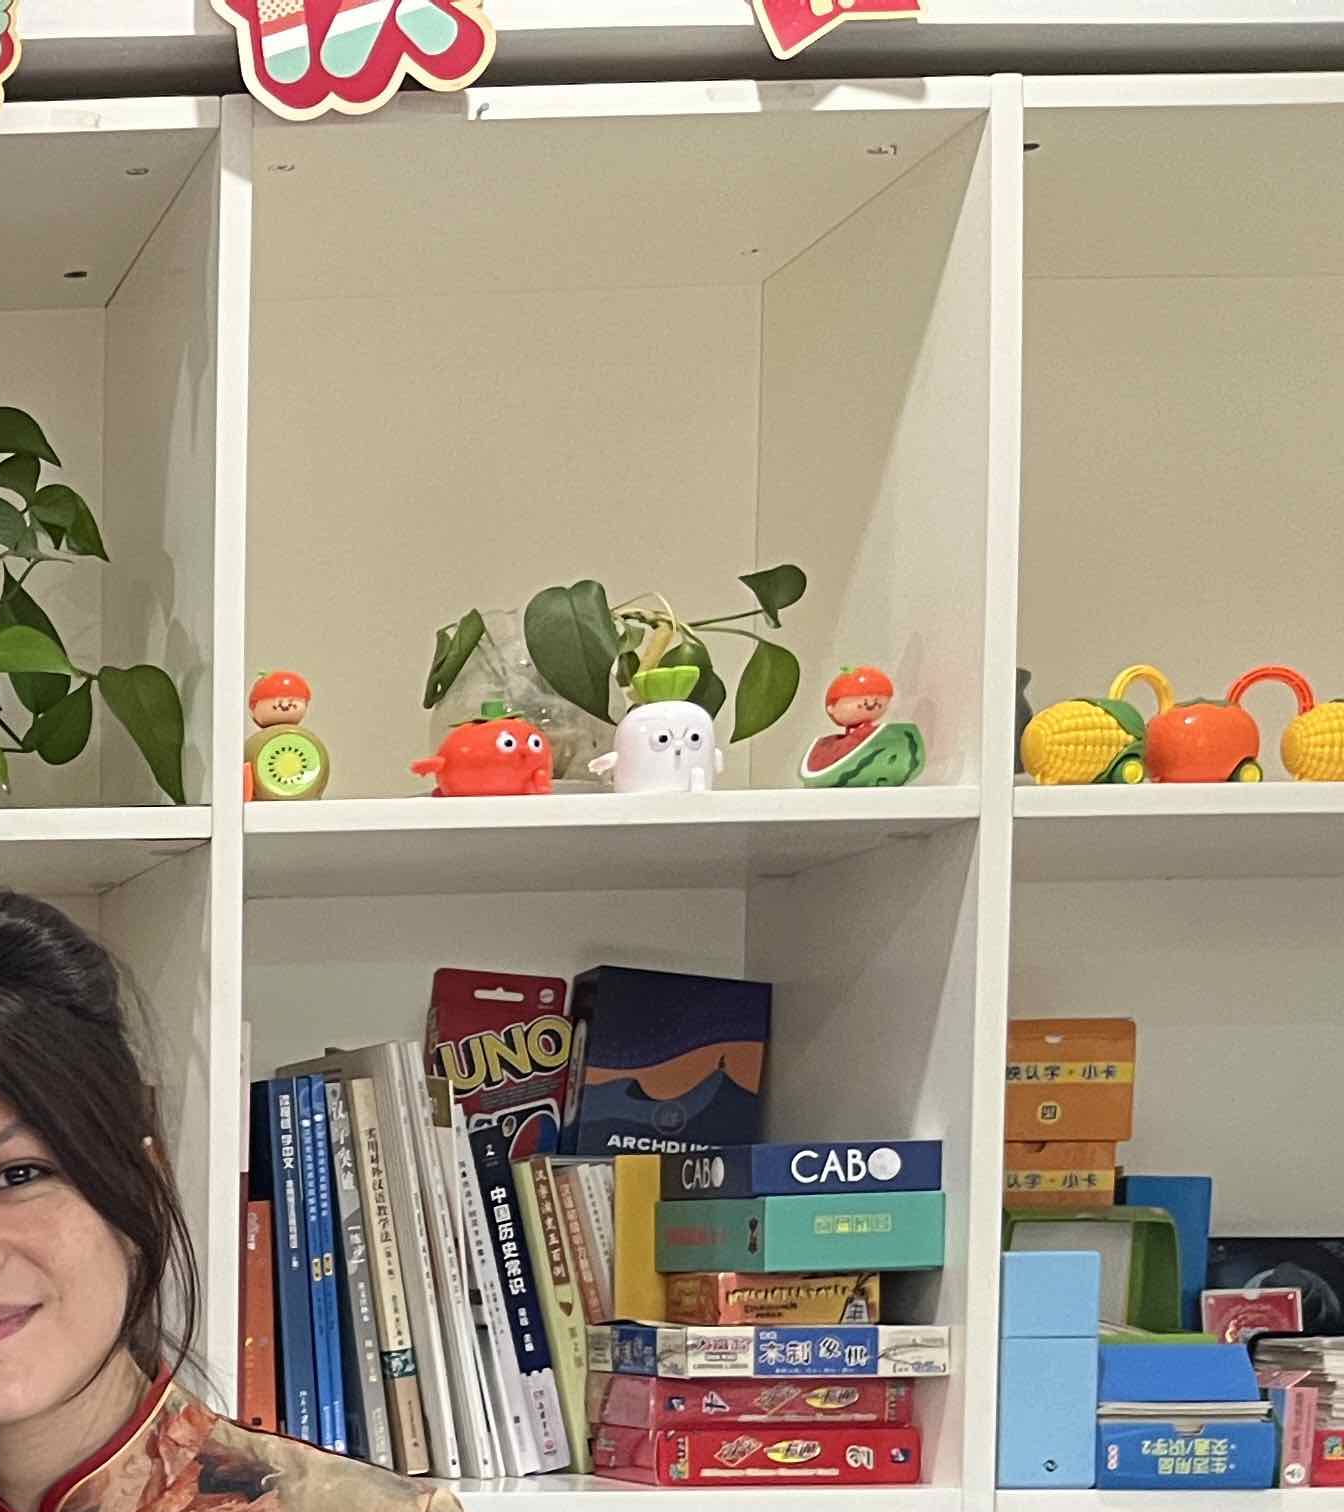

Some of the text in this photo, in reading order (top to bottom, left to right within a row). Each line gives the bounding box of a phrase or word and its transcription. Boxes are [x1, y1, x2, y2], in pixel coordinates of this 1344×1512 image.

[436, 1017, 572, 1093] UNO
[681, 1157, 724, 1190] CABO
[791, 1148, 901, 1184] CABO
[490, 1186, 527, 1296] 中国历史常识
